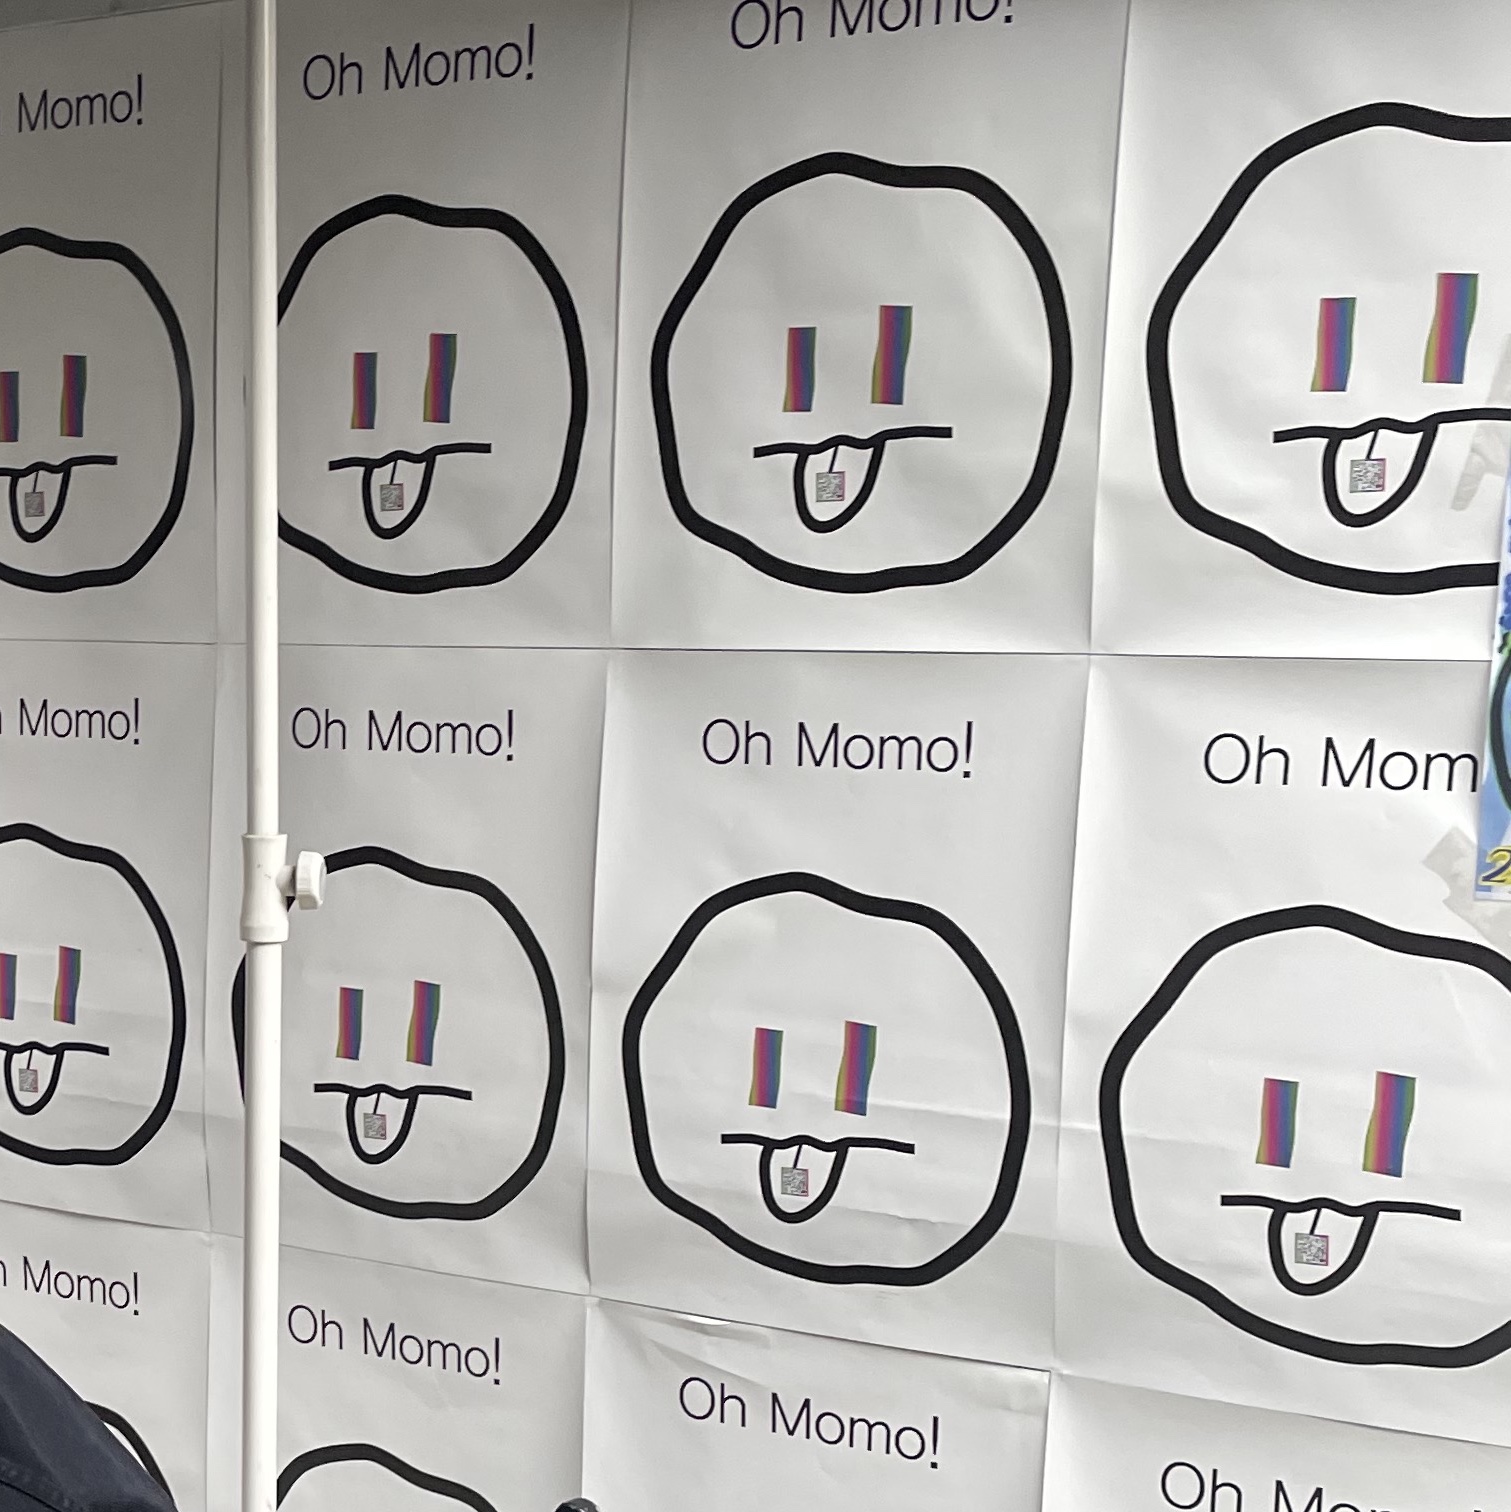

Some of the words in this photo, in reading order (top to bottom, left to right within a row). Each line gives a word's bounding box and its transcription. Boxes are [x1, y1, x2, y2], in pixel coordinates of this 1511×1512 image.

[730, 0, 804, 50] Oh
[302, 51, 363, 101] Oh
[384, 22, 535, 91] Momo!
[18, 72, 143, 134] Momo!
[19, 697, 140, 746] Momo!
[291, 706, 347, 751] Oh
[367, 708, 514, 762] Momo!
[702, 718, 772, 766] Oh
[797, 720, 974, 779] Momo!
[1203, 732, 1291, 786] Oh
[22, 1255, 140, 1317] Momo!
[287, 1304, 344, 1351] Oh
[362, 1317, 501, 1386] Momo!
[678, 1375, 747, 1428] Oh
[770, 1391, 940, 1470] Momo!
